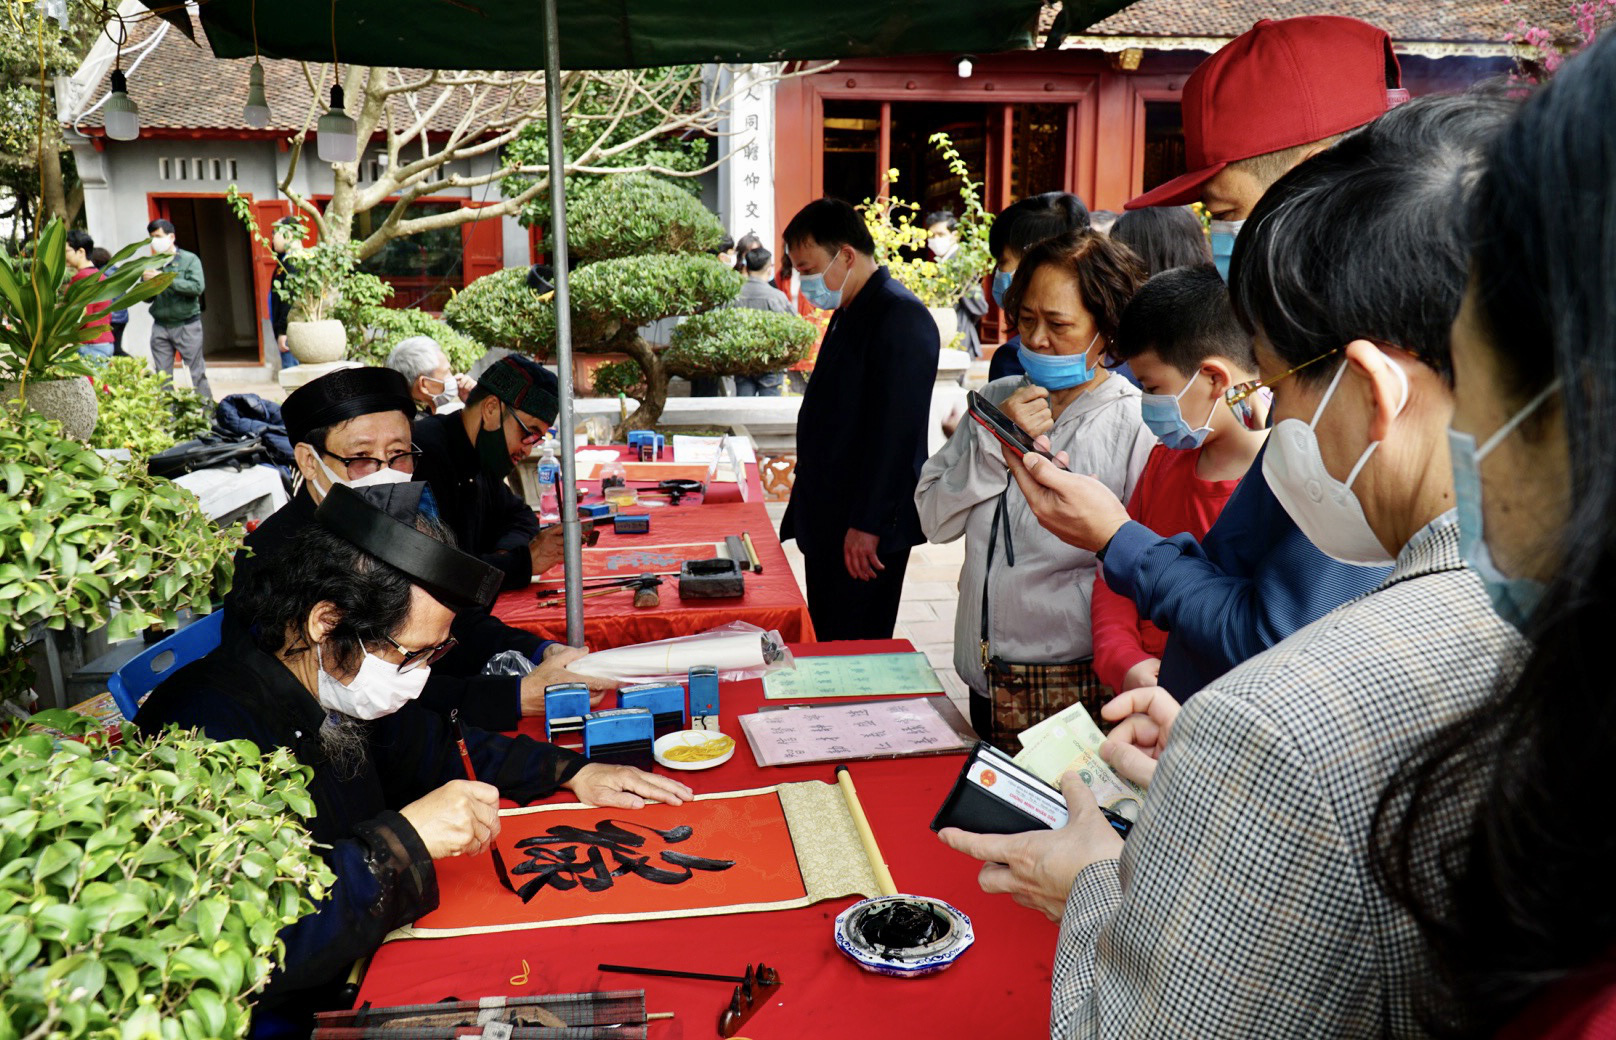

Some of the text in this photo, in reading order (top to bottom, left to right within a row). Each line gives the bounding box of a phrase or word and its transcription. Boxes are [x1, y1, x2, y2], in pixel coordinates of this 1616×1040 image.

[743, 86, 761, 236] 人同瞻仰交
